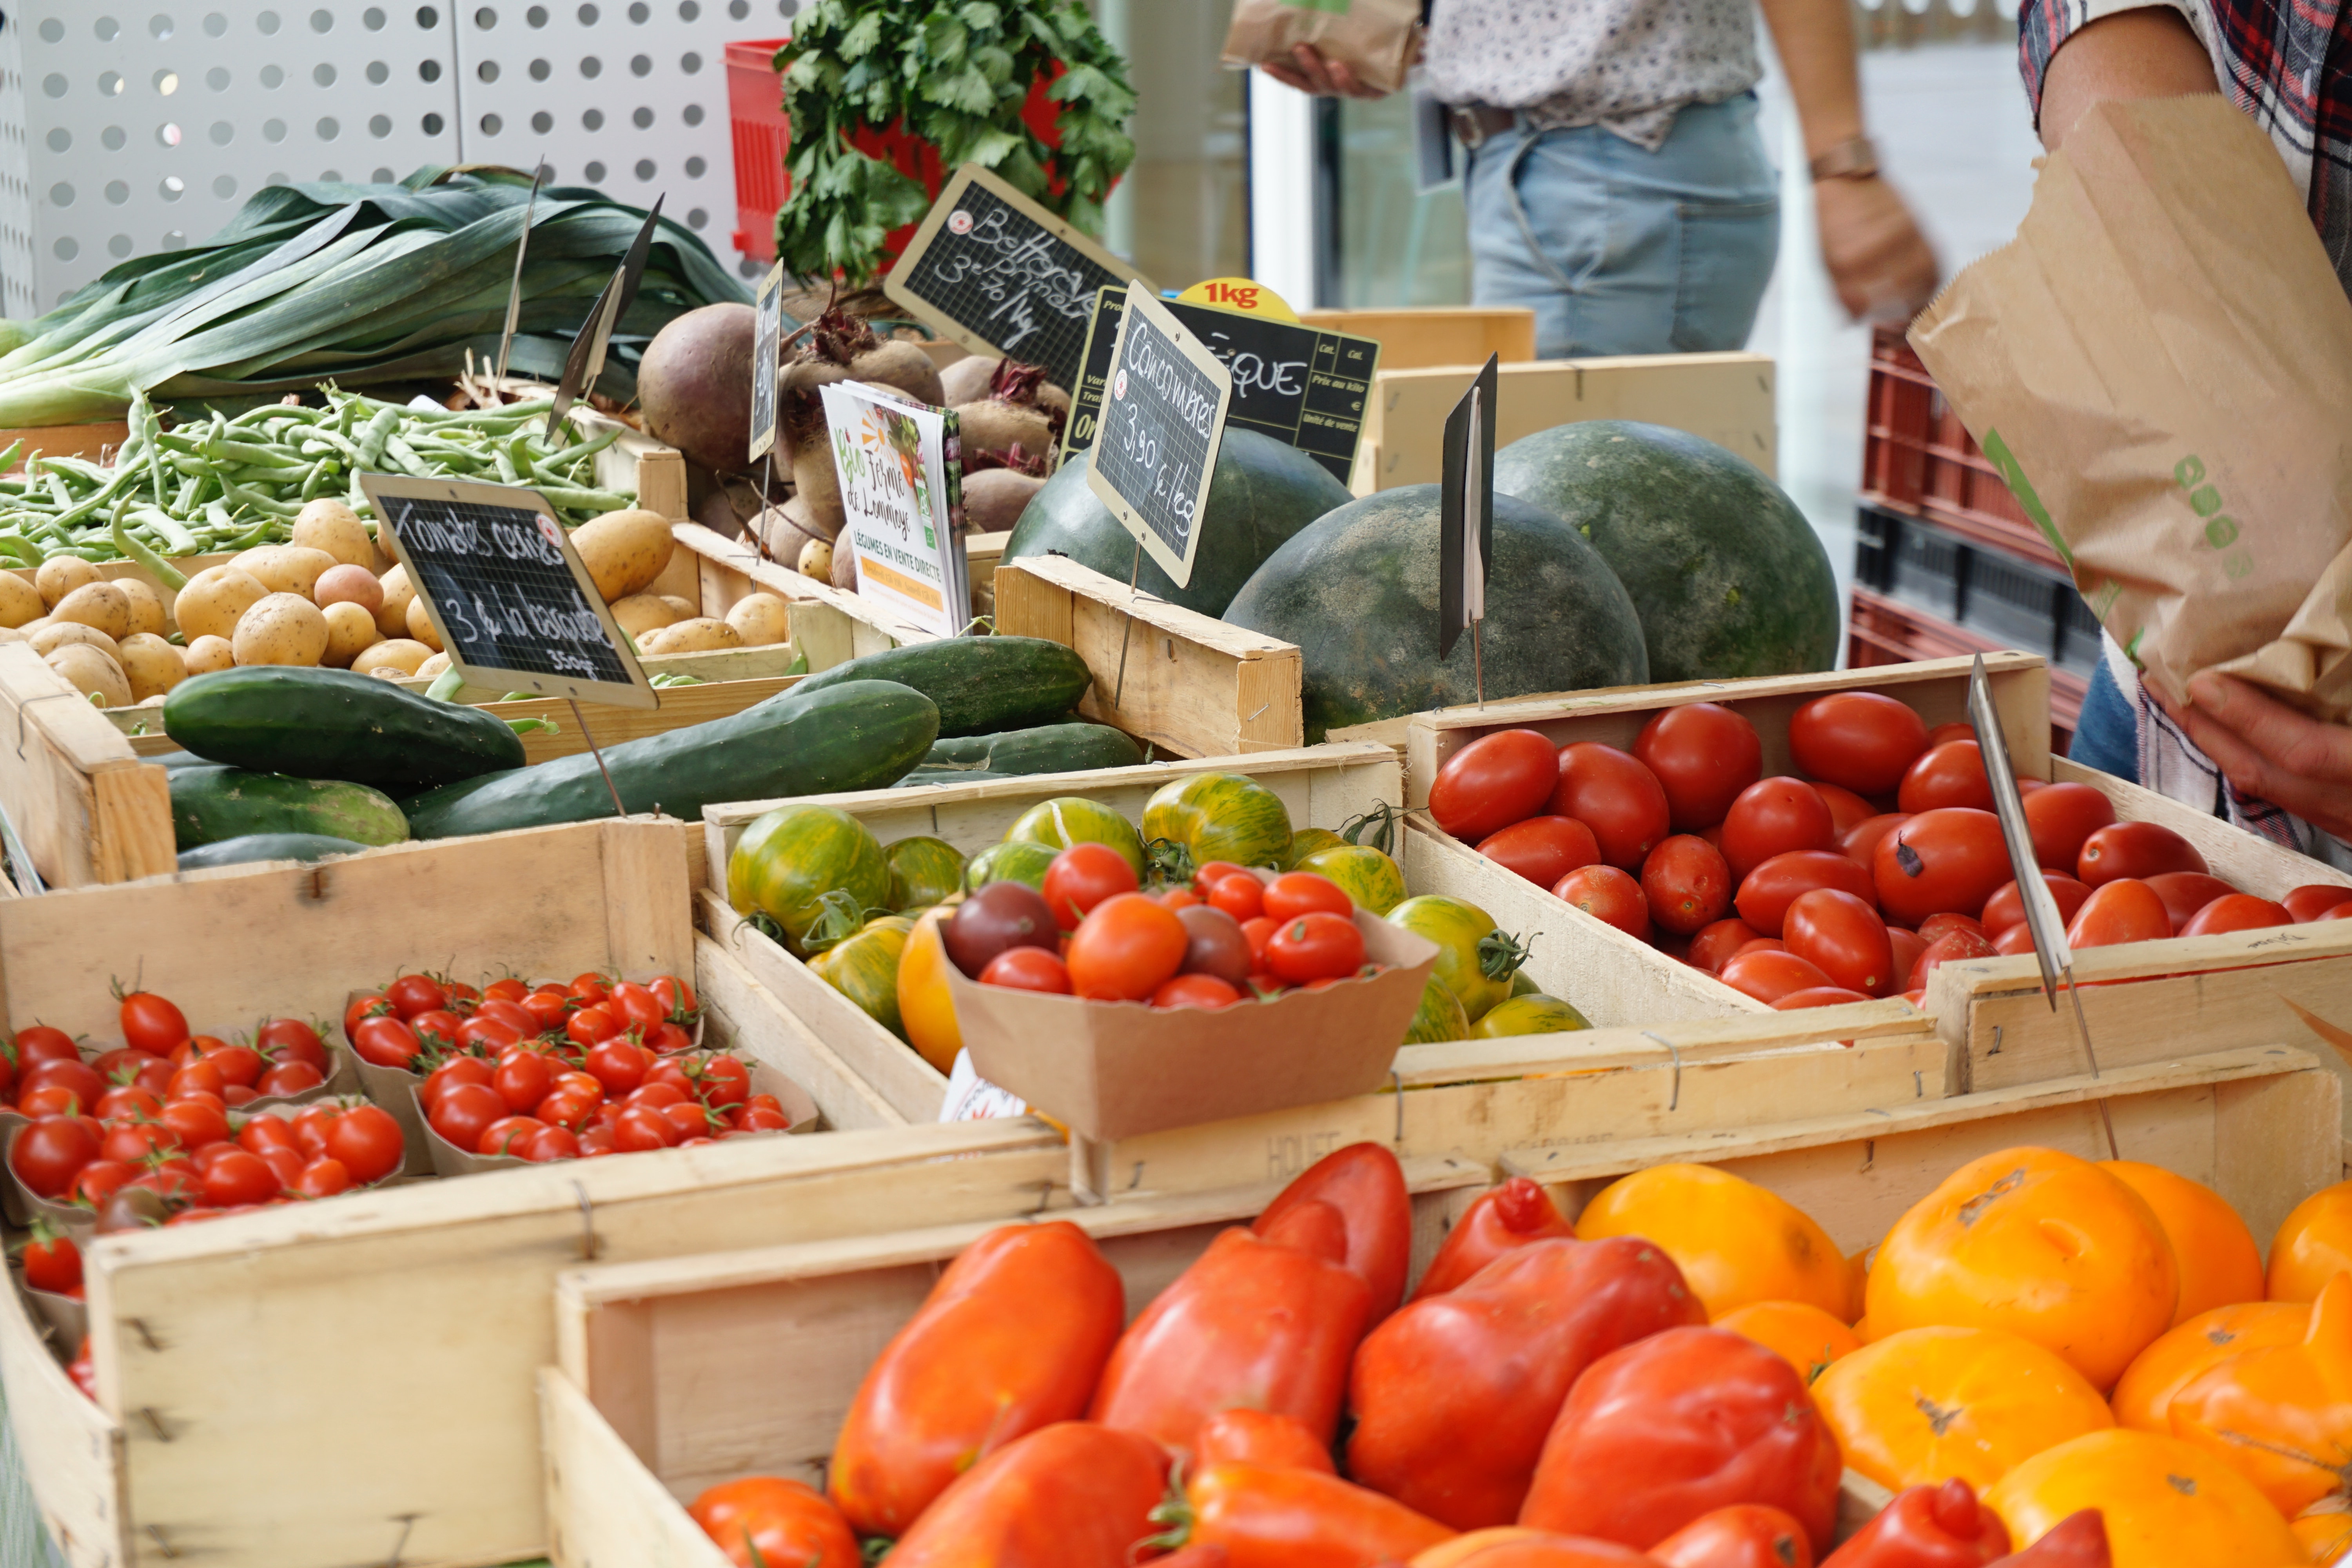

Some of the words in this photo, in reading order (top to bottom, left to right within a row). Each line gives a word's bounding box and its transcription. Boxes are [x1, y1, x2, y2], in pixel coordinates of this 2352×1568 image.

[1204, 283, 1259, 309] 1kg
[1129, 323, 1216, 439] Concombres
[1312, 375, 1332, 386] Prix
[1332, 380, 1346, 390] au
[1346, 382, 1365, 393] kilo
[1351, 401, 1362, 411] €
[1303, 413, 1325, 425] Unité
[1324, 418, 1335, 428] de
[1335, 421, 1358, 432] vente
[834, 427, 866, 483] Bio
[865, 449, 905, 501] Ferme
[396, 502, 493, 557] Tomates
[848, 481, 860, 512] de
[864, 487, 910, 542] Lommoye
[854, 528, 883, 556] LÉGUMES
[884, 543, 893, 561] EN
[893, 546, 914, 570] VENTE
[915, 556, 941, 583] DIRECTE
[490, 584, 535, 640] la
